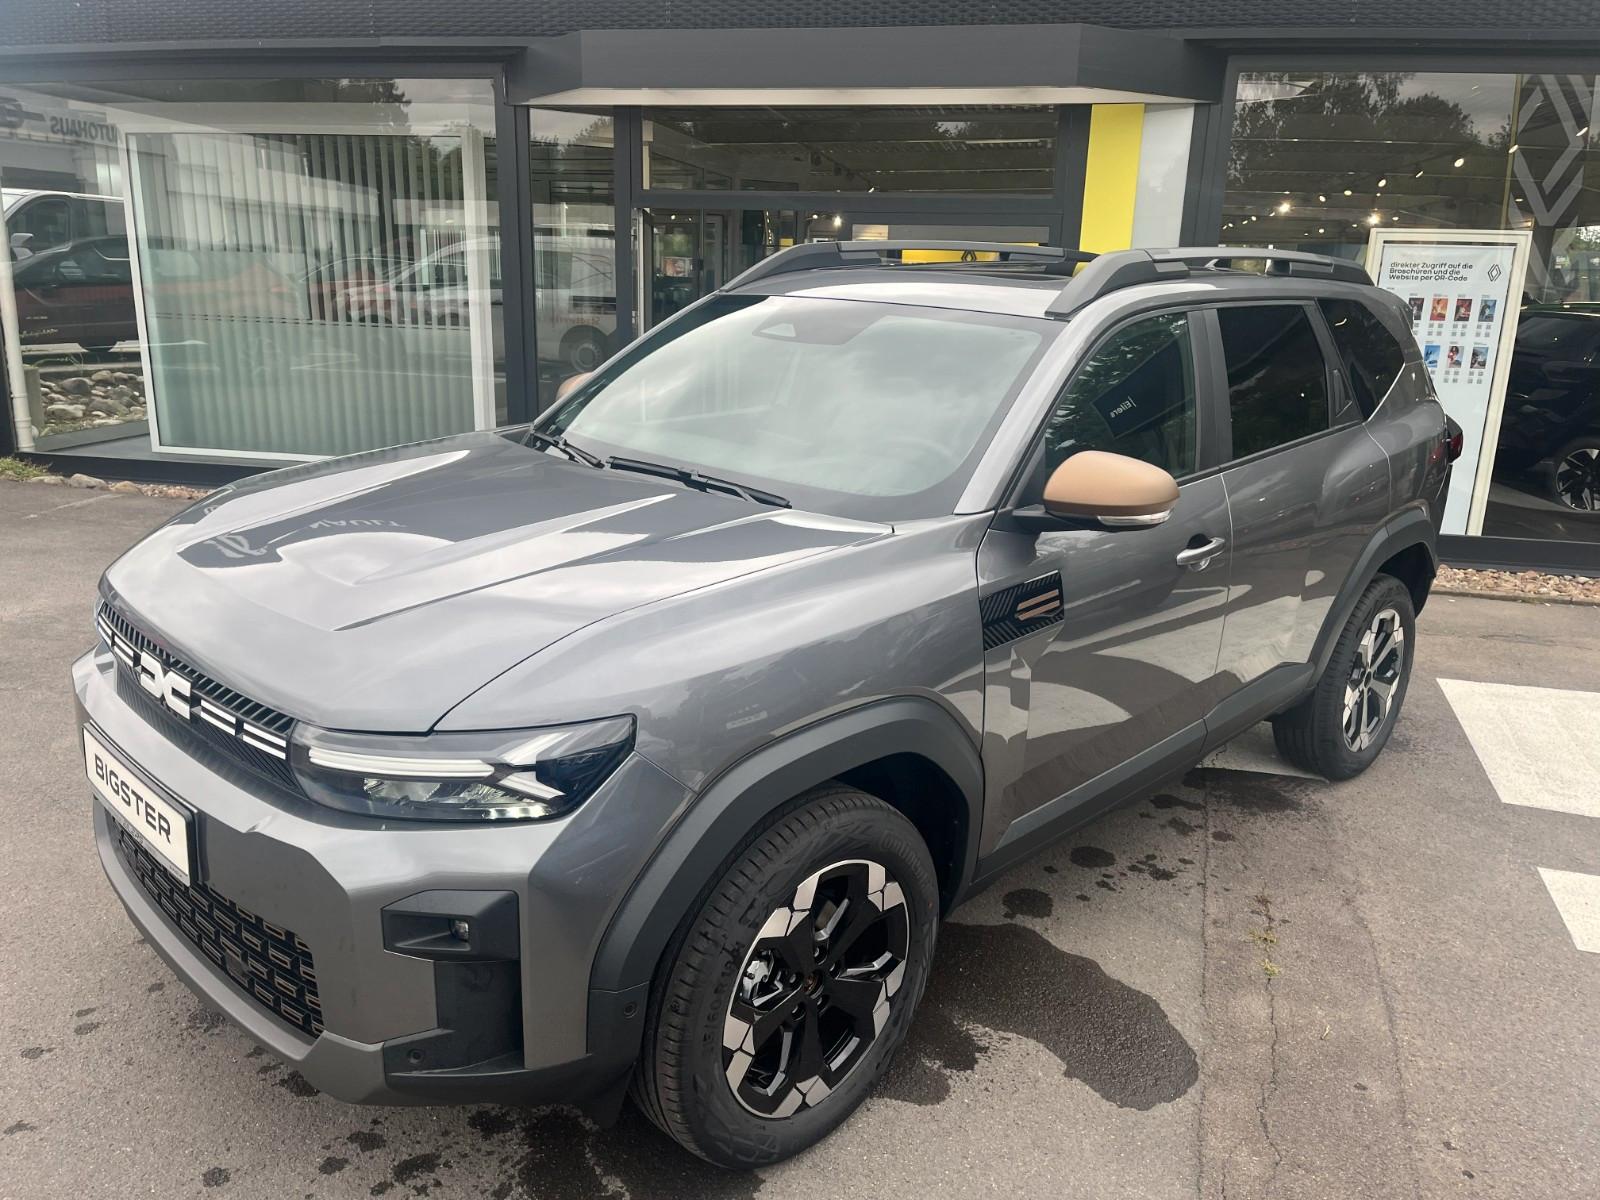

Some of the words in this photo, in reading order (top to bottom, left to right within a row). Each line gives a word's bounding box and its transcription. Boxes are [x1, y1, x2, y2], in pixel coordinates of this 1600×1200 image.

[1390, 261, 1420, 269] direkter
[1421, 262, 1447, 270] Zugriff
[94, 753, 171, 844] BIGSTER
